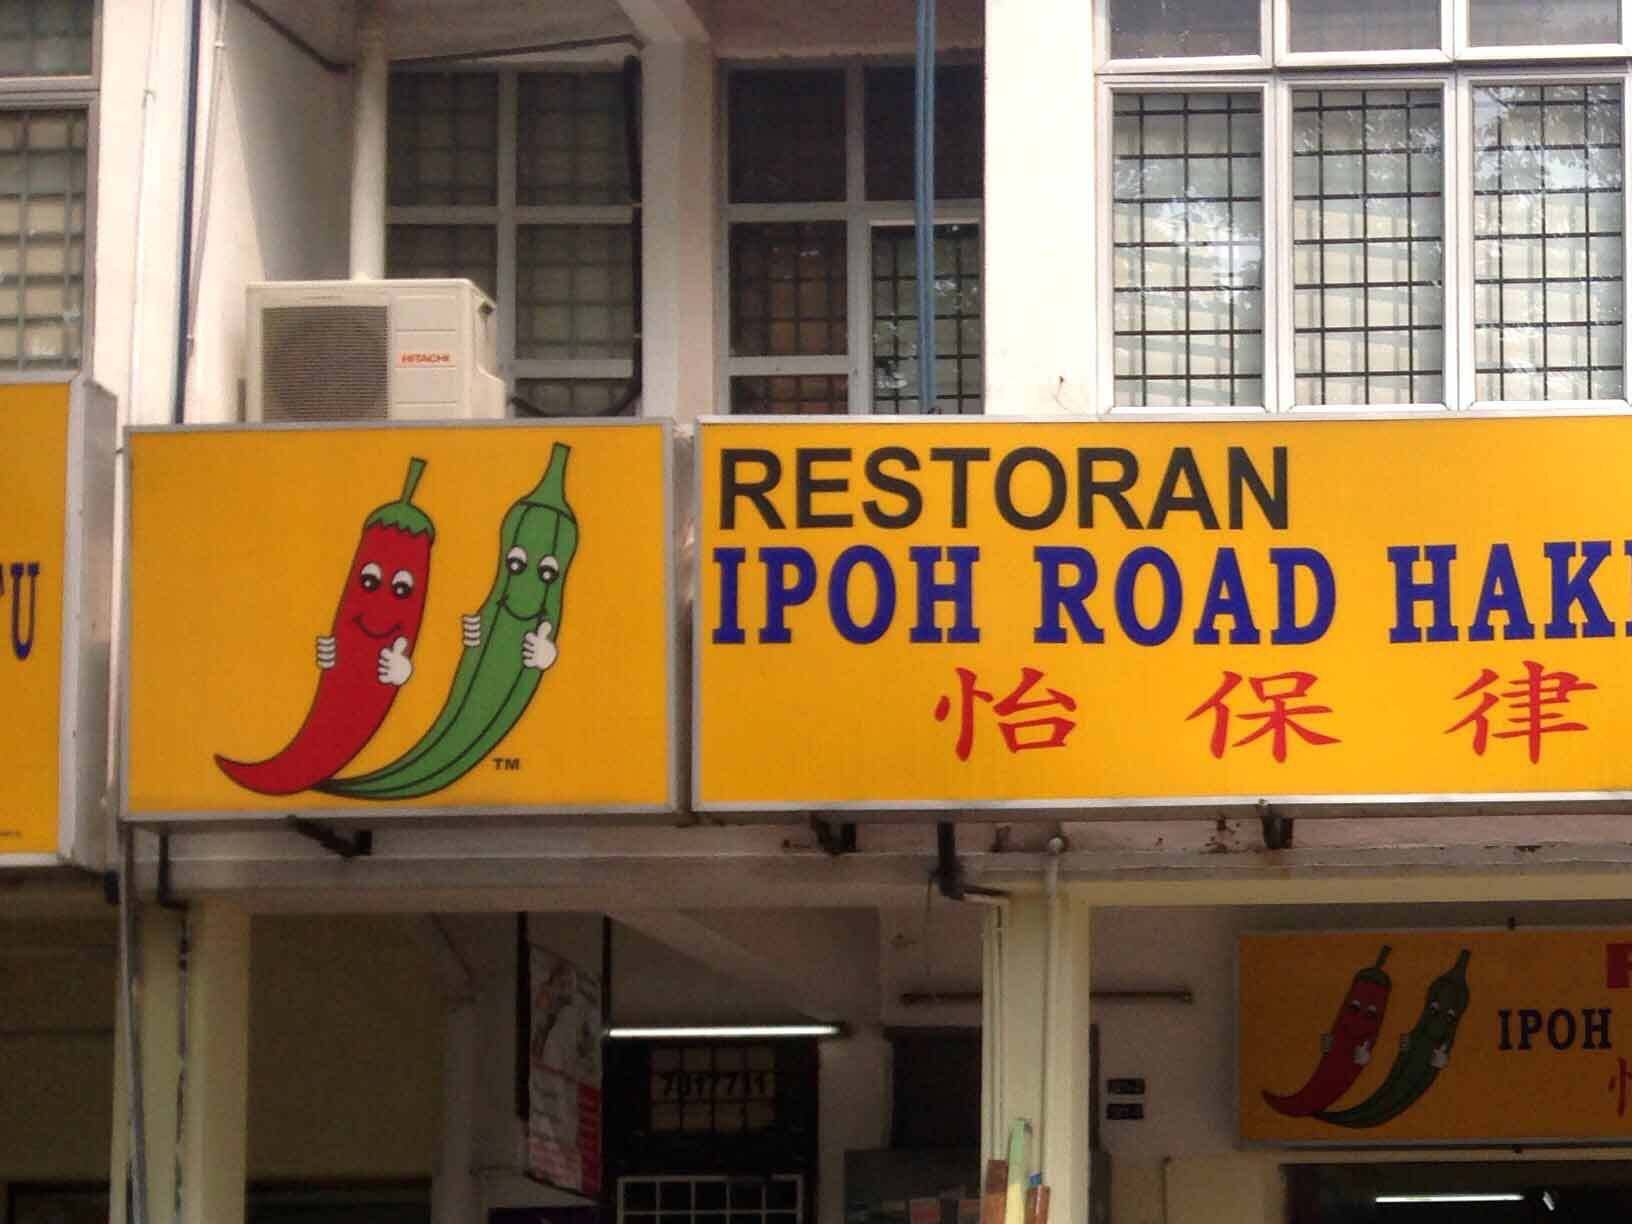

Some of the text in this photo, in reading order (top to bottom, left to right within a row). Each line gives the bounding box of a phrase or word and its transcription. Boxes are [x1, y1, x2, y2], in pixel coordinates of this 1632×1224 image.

[401, 352, 449, 364] HITACHI
[718, 446, 1289, 531] RESTORAN
[0, 562, 40, 660] U
[711, 544, 981, 646] IPOH
[1032, 545, 1337, 647] ROAD
[493, 757, 520, 771] TM
[1497, 1007, 1612, 1051] IPOH
